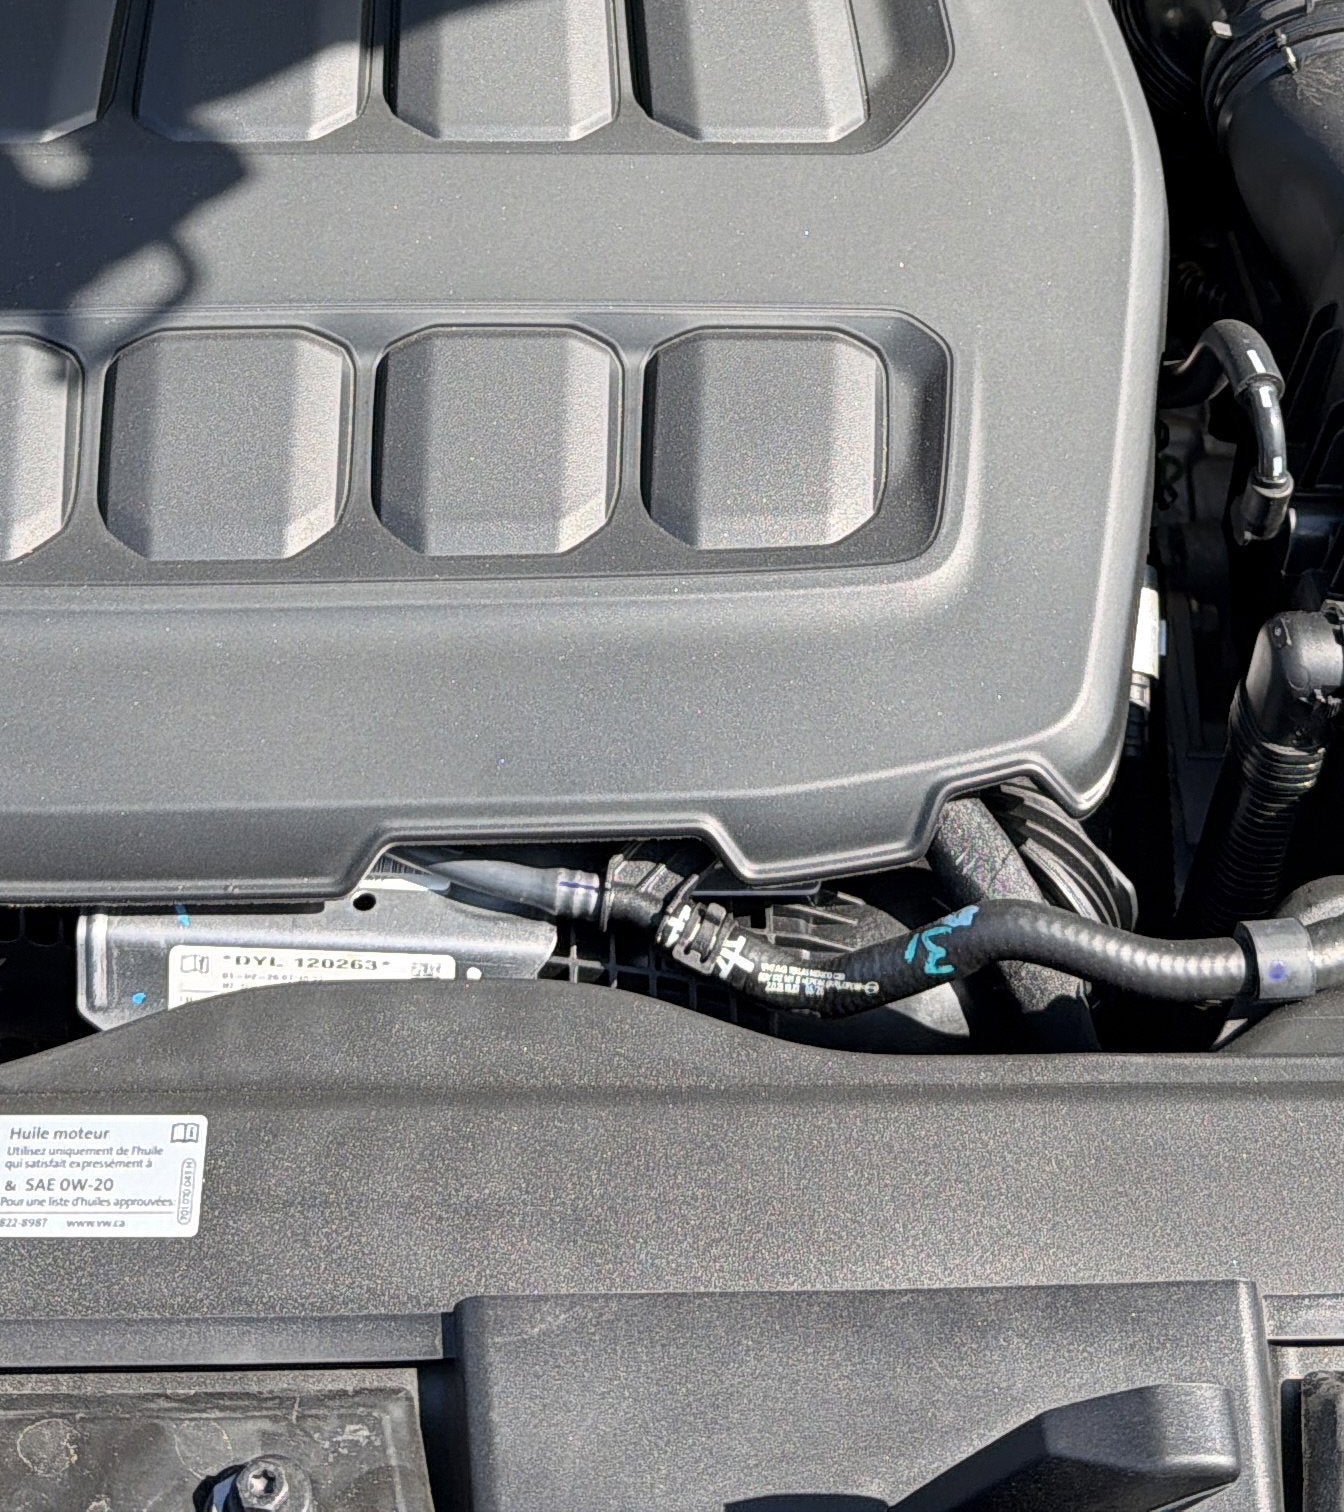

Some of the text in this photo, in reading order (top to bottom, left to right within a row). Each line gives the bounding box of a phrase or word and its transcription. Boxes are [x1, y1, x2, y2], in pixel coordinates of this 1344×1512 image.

[10, 1126, 49, 1140] Huile
[53, 1128, 110, 1140] moteur
[7, 1146, 46, 1156] Utilisez
[48, 1147, 114, 1158] uniquement
[116, 1146, 129, 1156] de
[5, 1159, 23, 1171] qui
[24, 1158, 67, 1169] satisfait
[68, 1158, 144, 1171] expressément
[5, 1180, 16, 1191] &
[26, 1178, 57, 1192] SAE
[59, 1178, 114, 1192] 0W-20
[0, 1197, 25, 1207] Pour
[26, 1198, 46, 1207] une
[48, 1197, 70, 1207] liste
[66, 1219, 126, 1228] www.vw.ca
